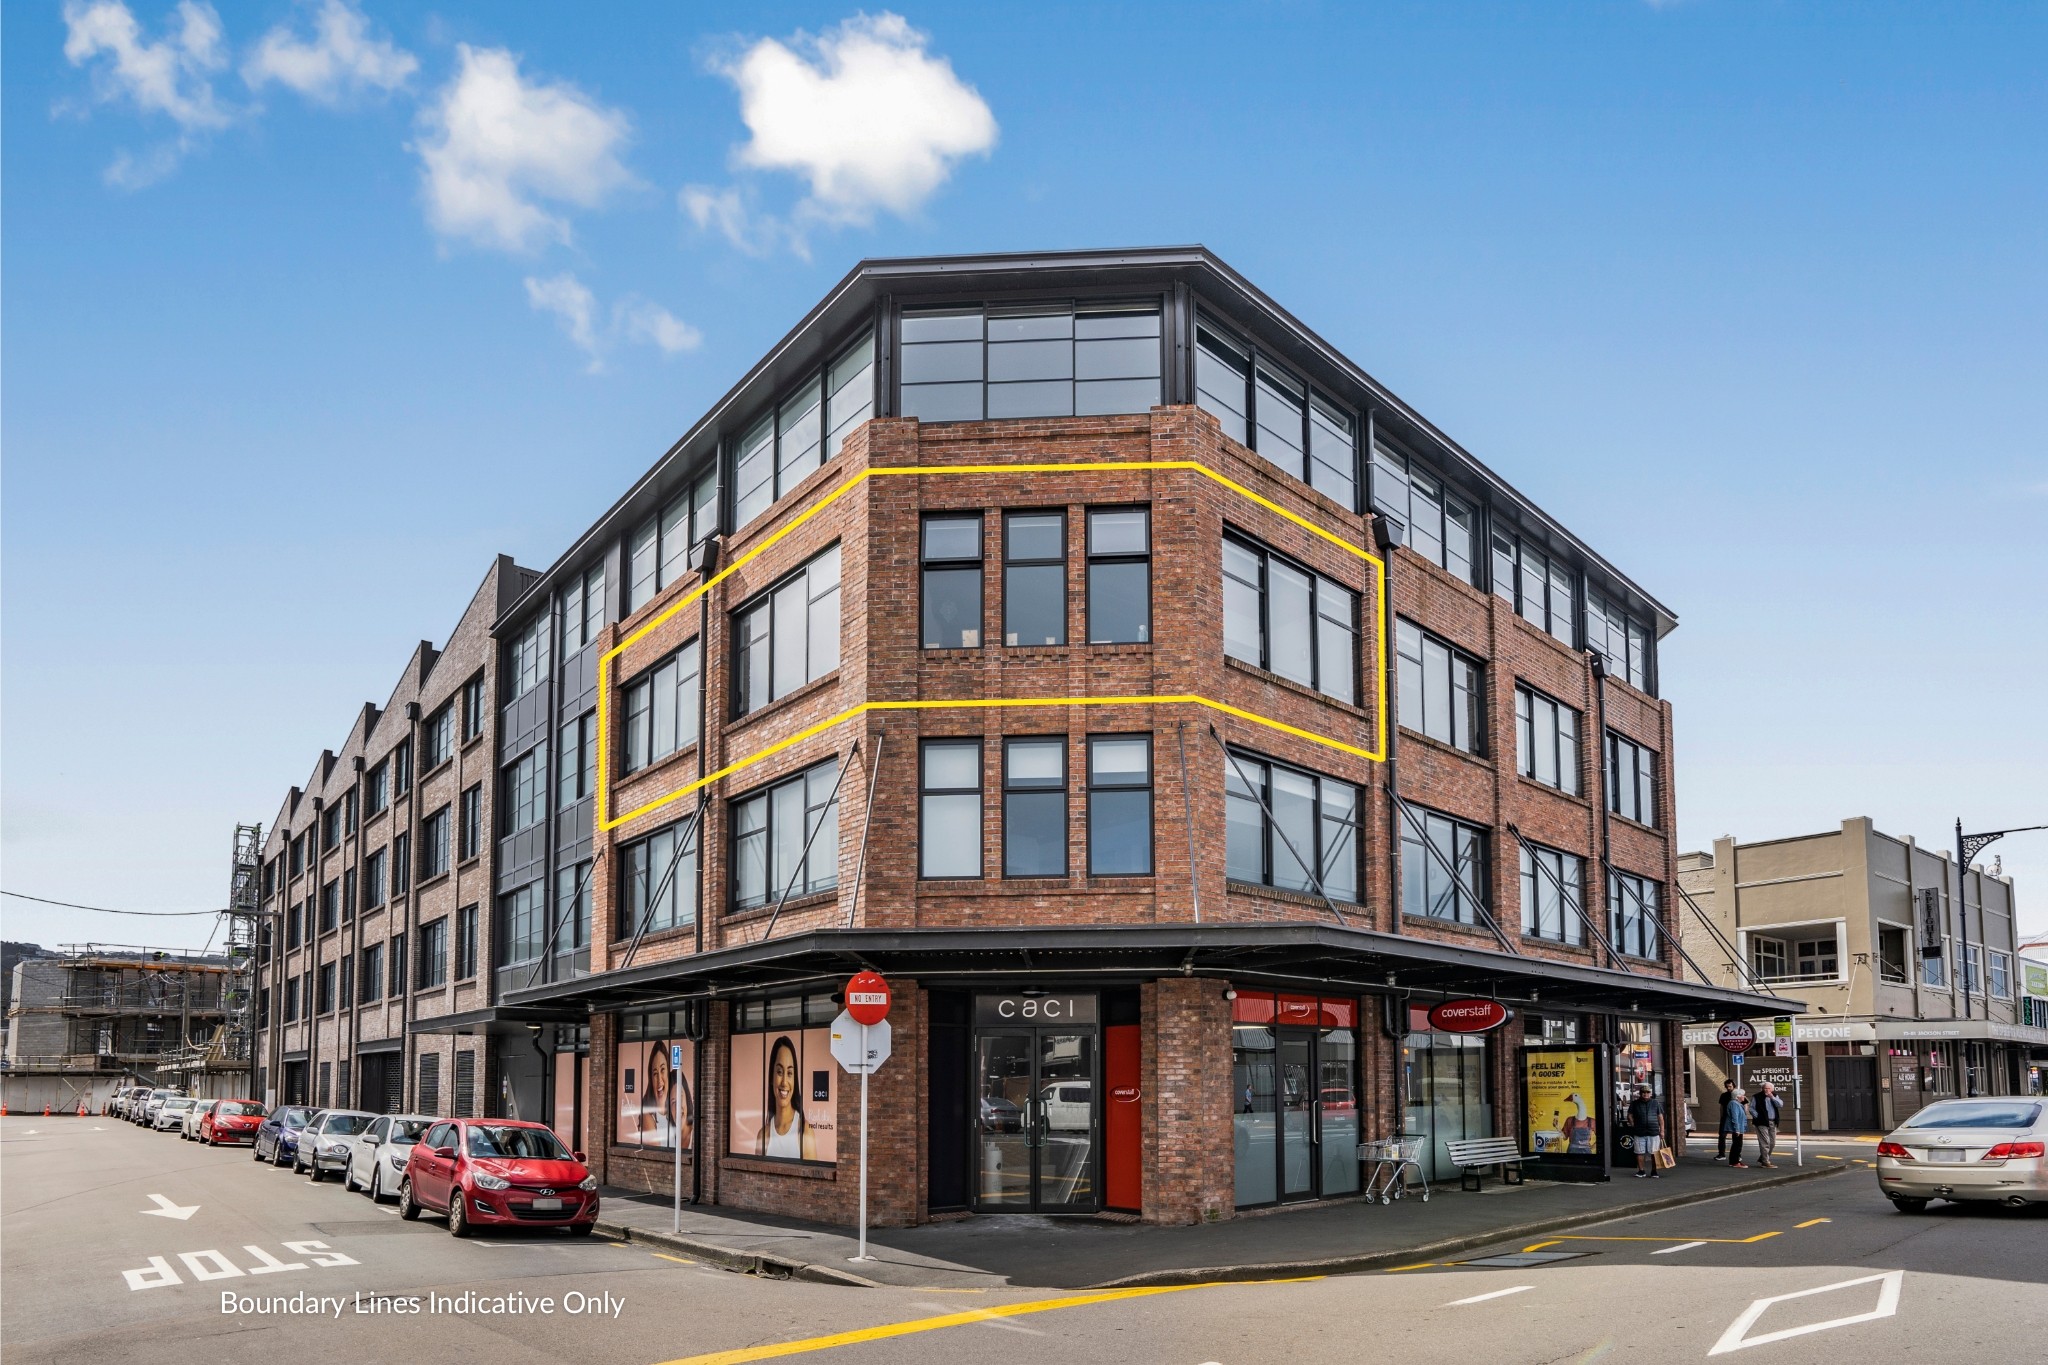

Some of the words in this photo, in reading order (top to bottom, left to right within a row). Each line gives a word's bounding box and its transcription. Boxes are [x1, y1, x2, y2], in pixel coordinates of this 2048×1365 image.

[854, 994, 862, 1003] NO
[865, 994, 882, 1003] ENTRY
[1441, 1003, 1492, 1018] coverstaff
[1683, 1031, 1717, 1042] GHT'S
[1798, 1026, 1851, 1039] PETONE
[1722, 1025, 1750, 1037] Sal's
[1531, 1062, 1548, 1070] FEEL
[1550, 1062, 1566, 1070] LIKE
[1538, 1070, 1565, 1078] GOOSE?
[1749, 1074, 1767, 1082] ALE
[121, 1240, 363, 1292] STOP
